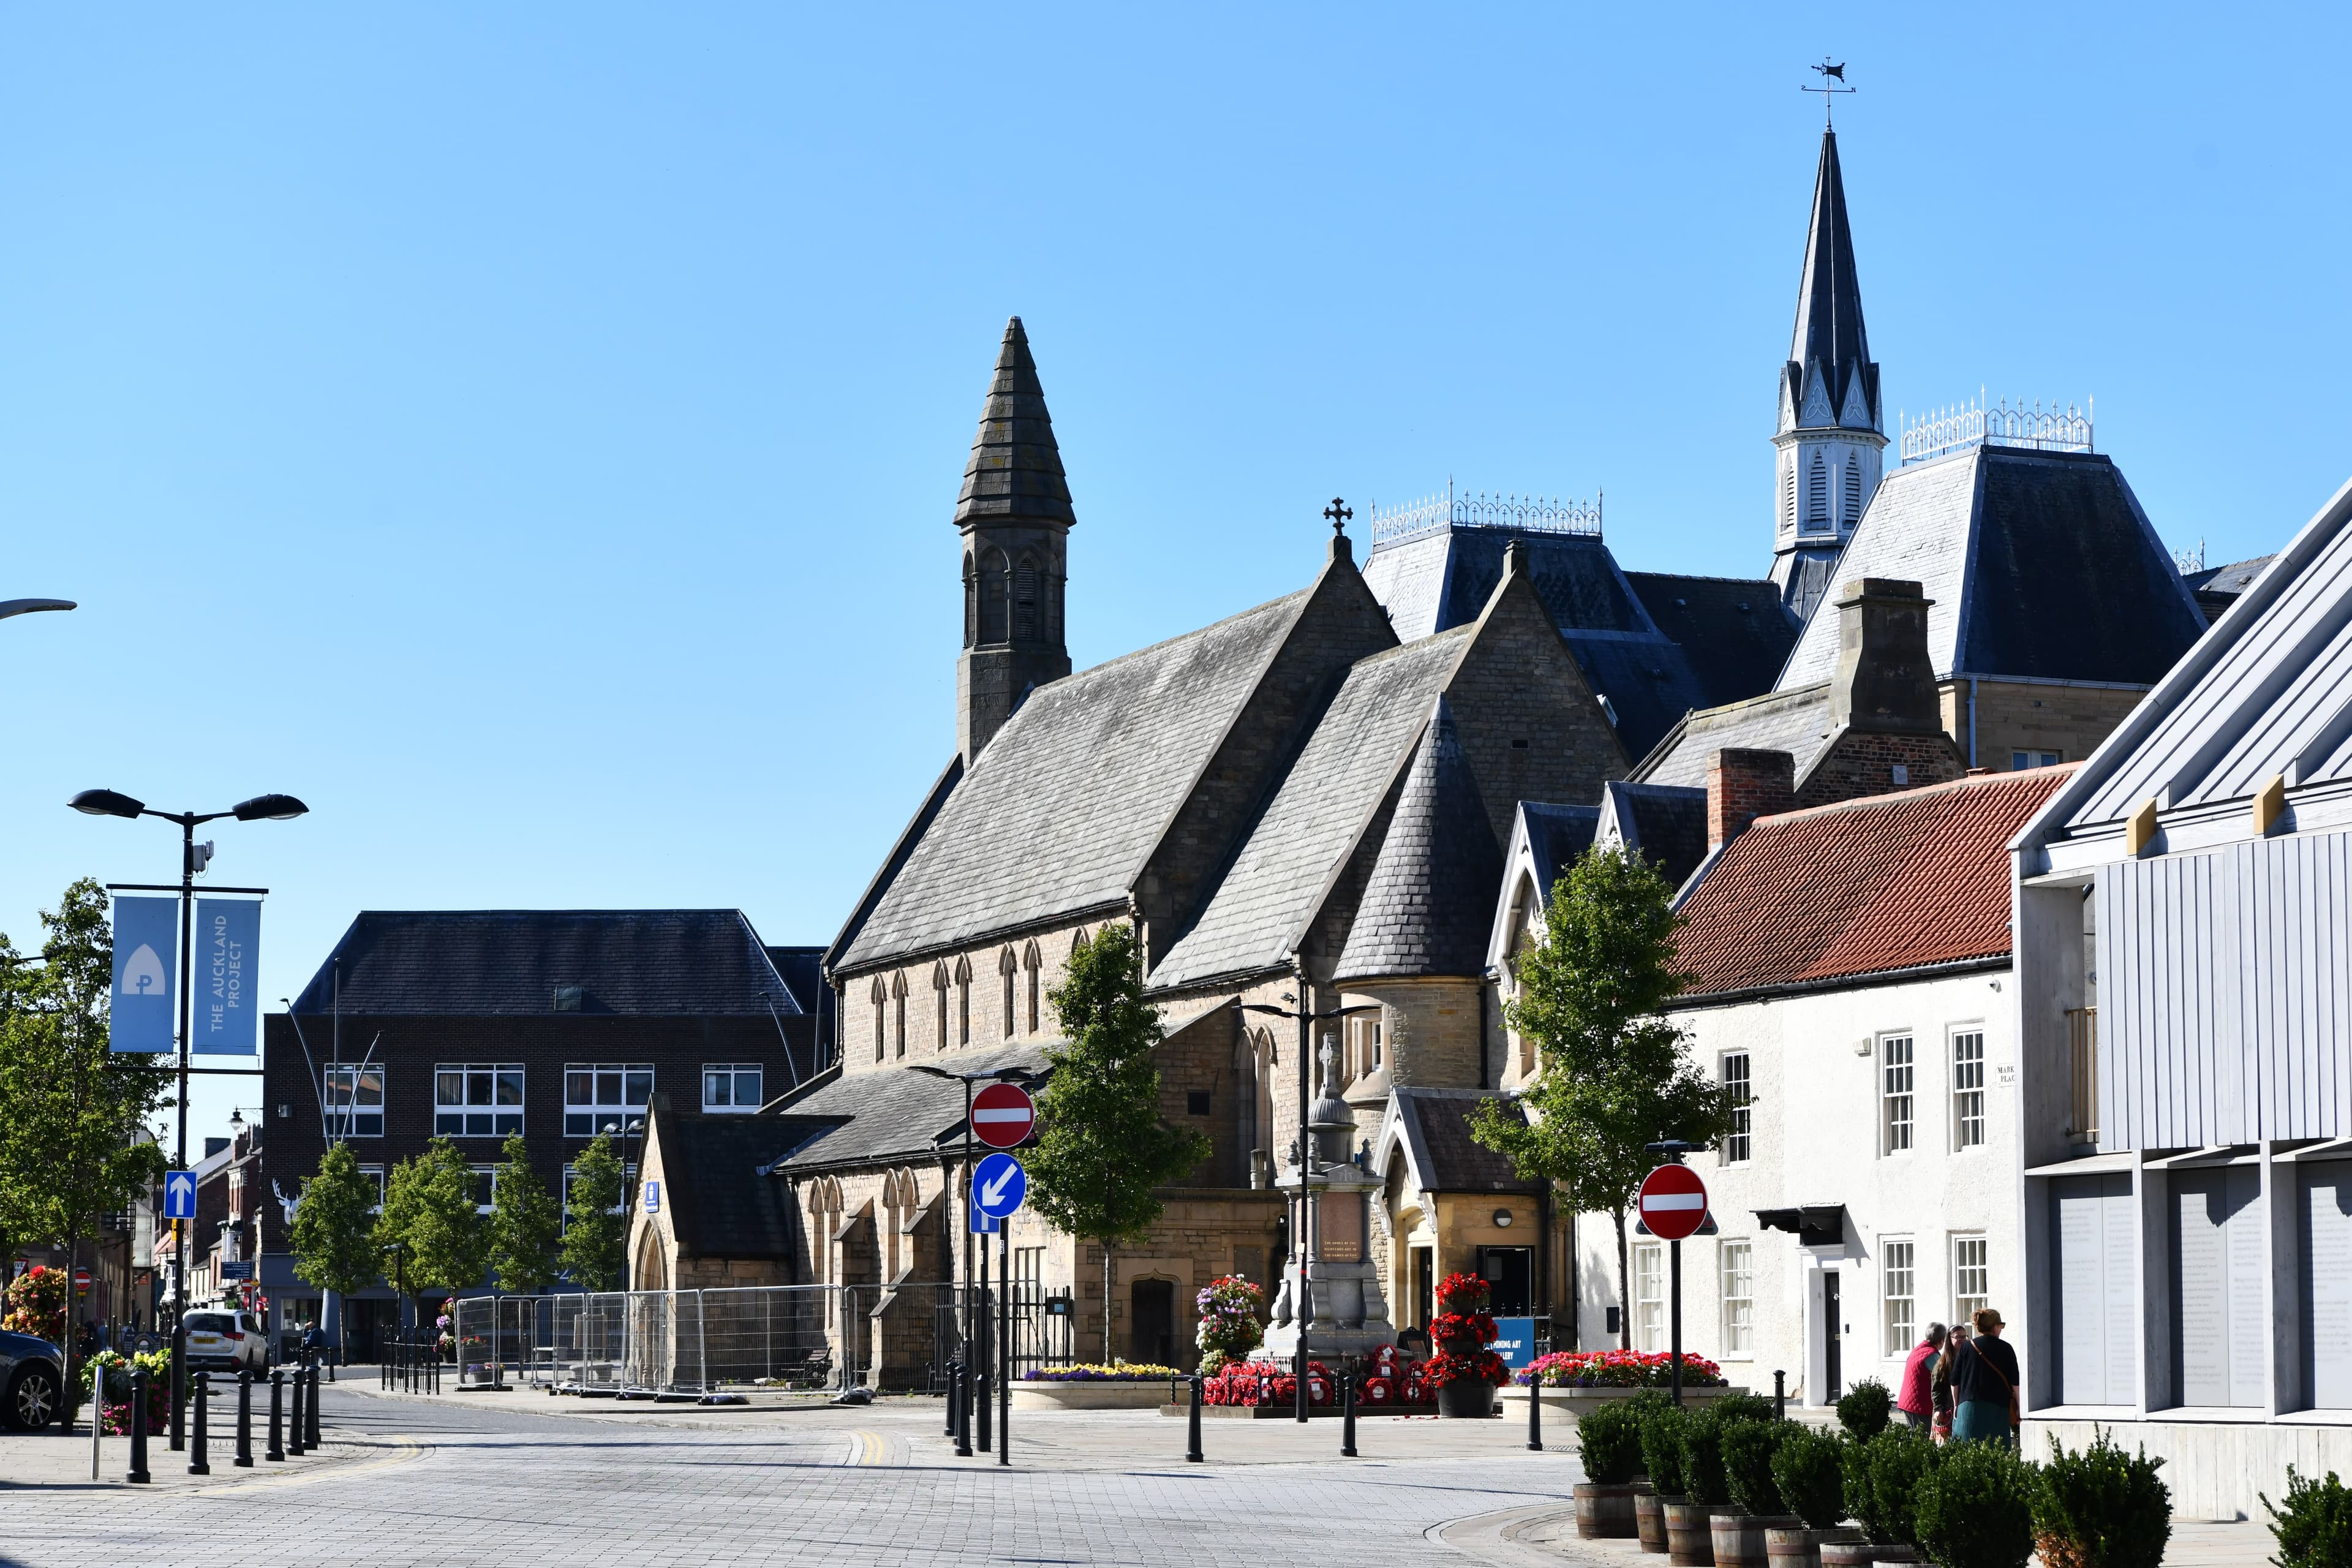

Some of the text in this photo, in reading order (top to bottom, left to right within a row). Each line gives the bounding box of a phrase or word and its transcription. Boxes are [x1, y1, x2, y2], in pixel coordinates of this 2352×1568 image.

[211, 915, 227, 1032] THE AUCKLAND
[228, 941, 242, 1008] PROJECT
[1493, 1340, 1521, 1349] MINING ART
[1494, 1351, 1514, 1360] LERY
